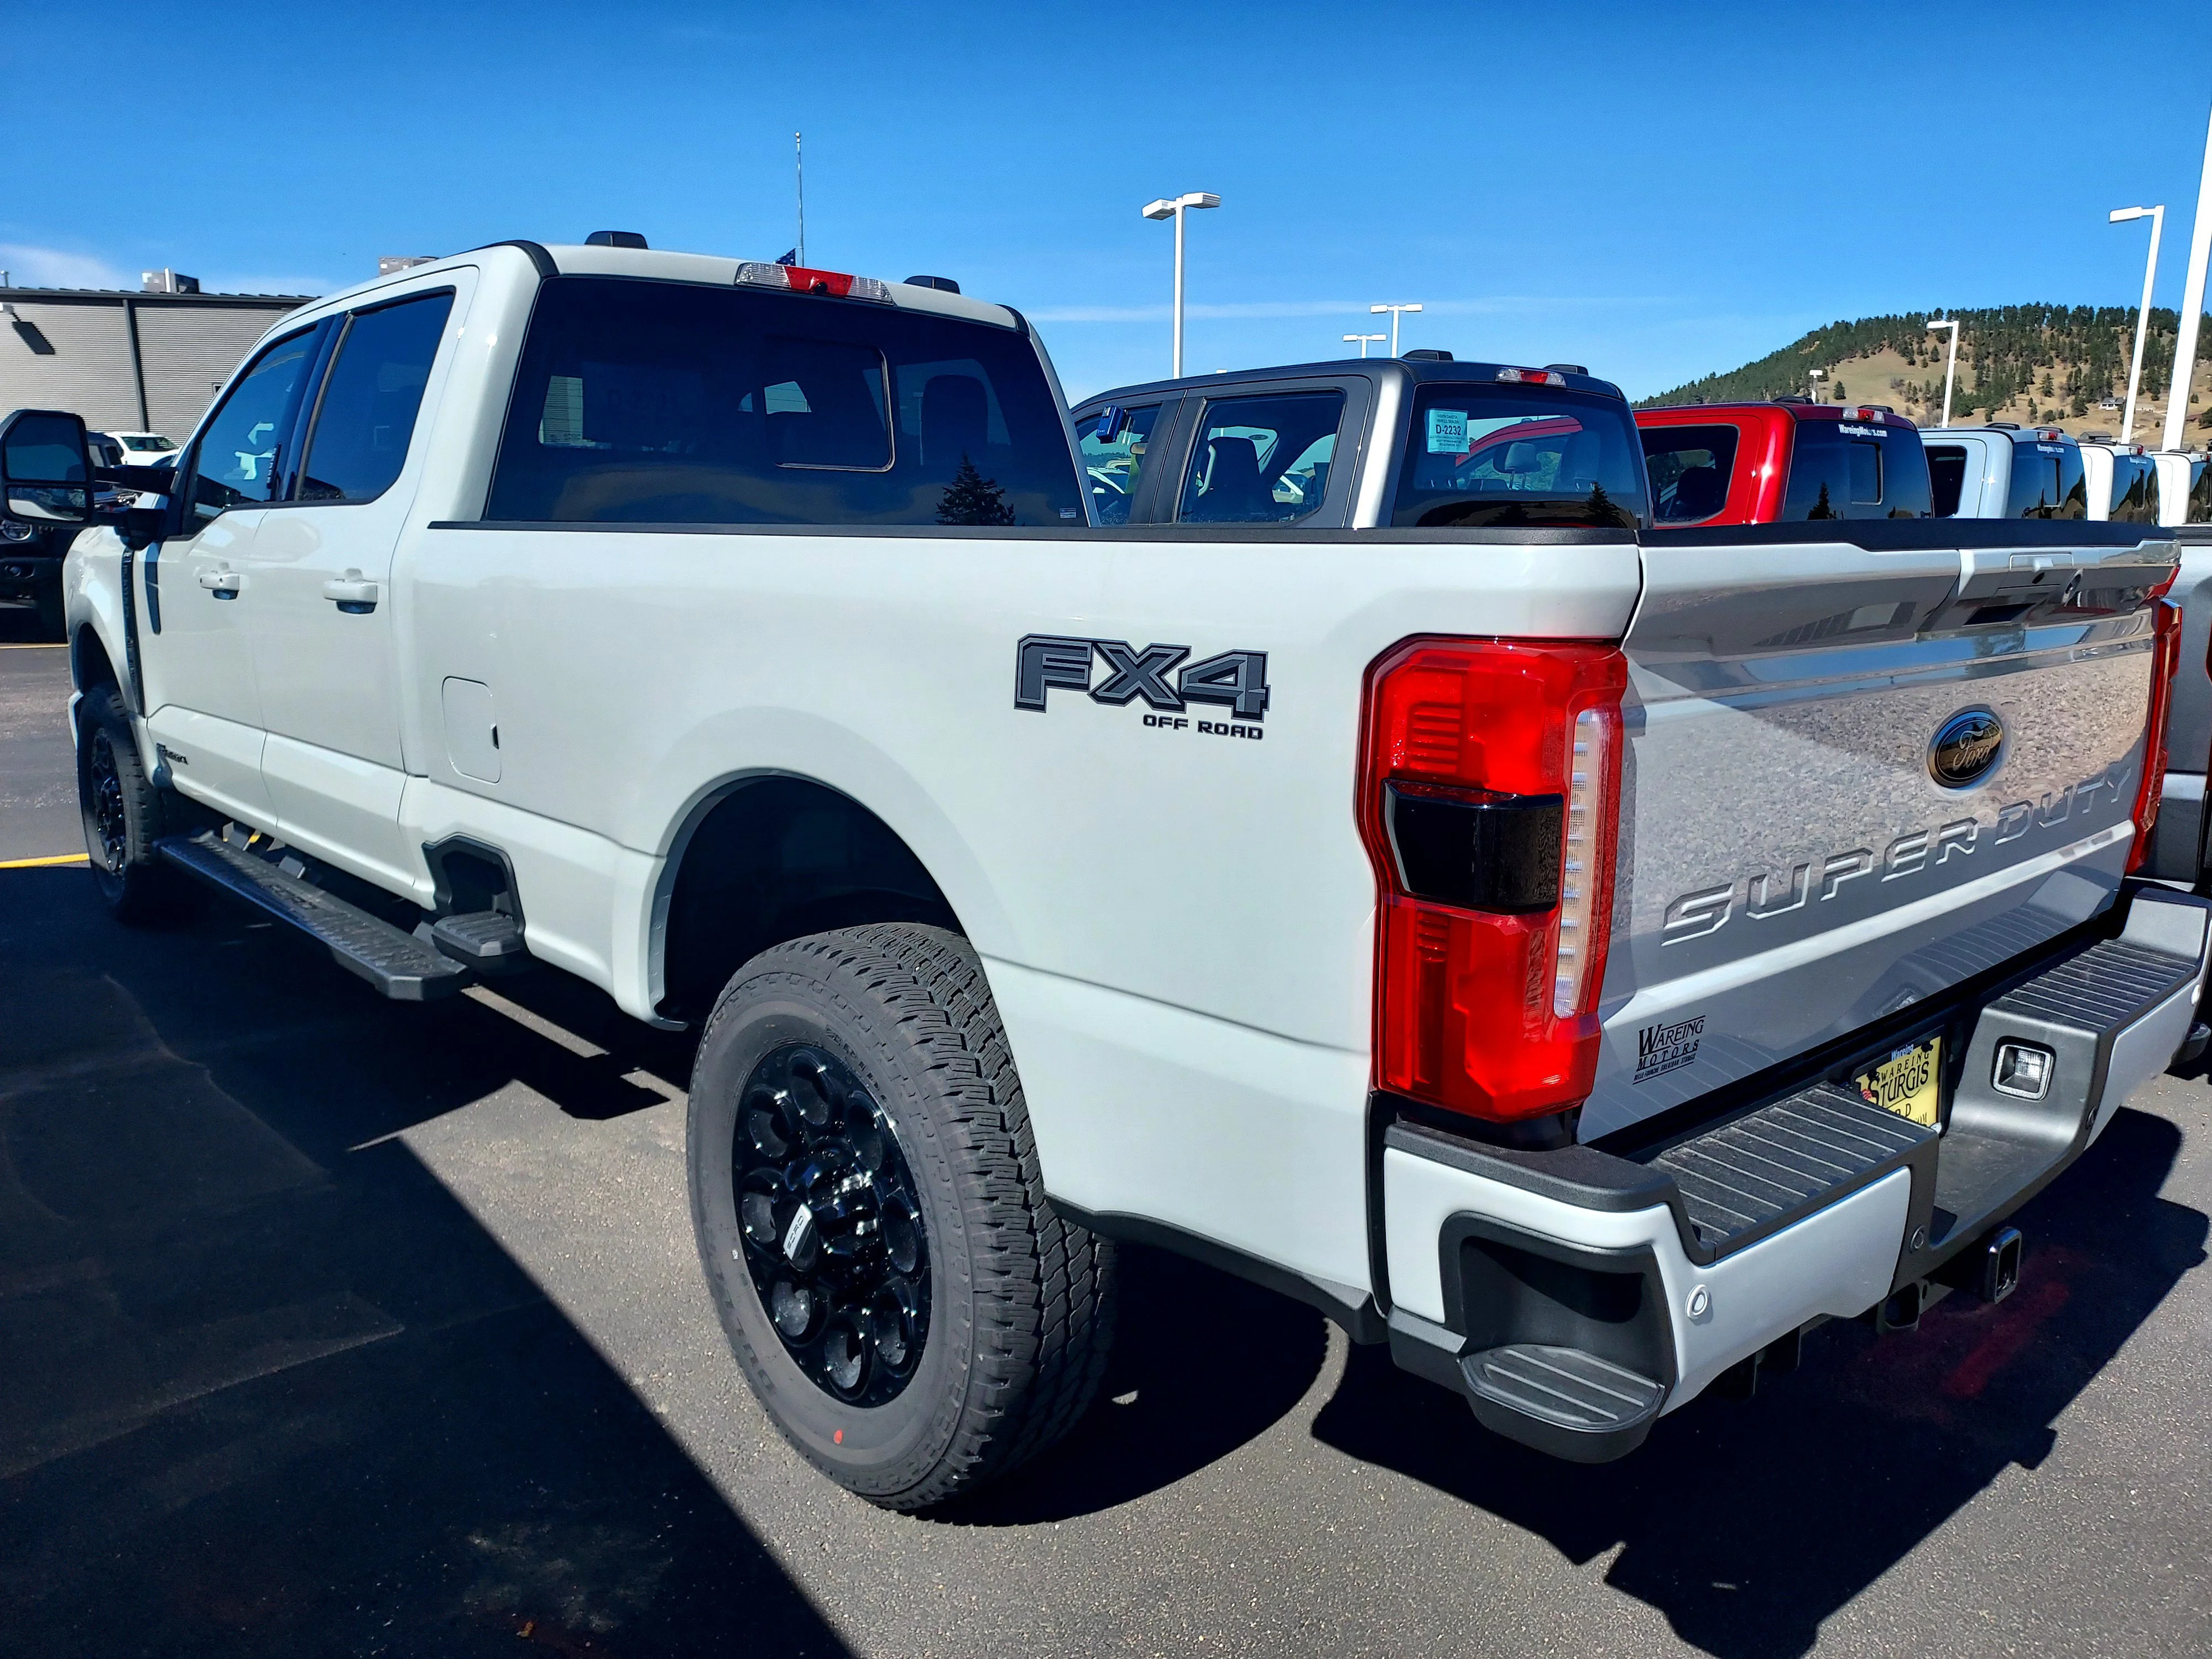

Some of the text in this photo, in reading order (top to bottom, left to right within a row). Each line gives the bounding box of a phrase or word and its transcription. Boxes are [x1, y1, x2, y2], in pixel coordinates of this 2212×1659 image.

[1436, 424, 1462, 435] D-2232
[1014, 633, 1271, 721] FX4
[1143, 714, 1264, 740] OFF ROAD
[1953, 728, 1993, 771] Ford
[1661, 769, 2131, 946] SUPER DUTY
[1639, 1019, 1704, 1057] WAREING
[1891, 1044, 1914, 1062] Wareing
[1636, 1039, 1699, 1072] MOTORS
[1881, 1052, 1929, 1082] WAREING
[1868, 1061, 1929, 1106] STURGIS
[787, 1215, 804, 1249] FORD
